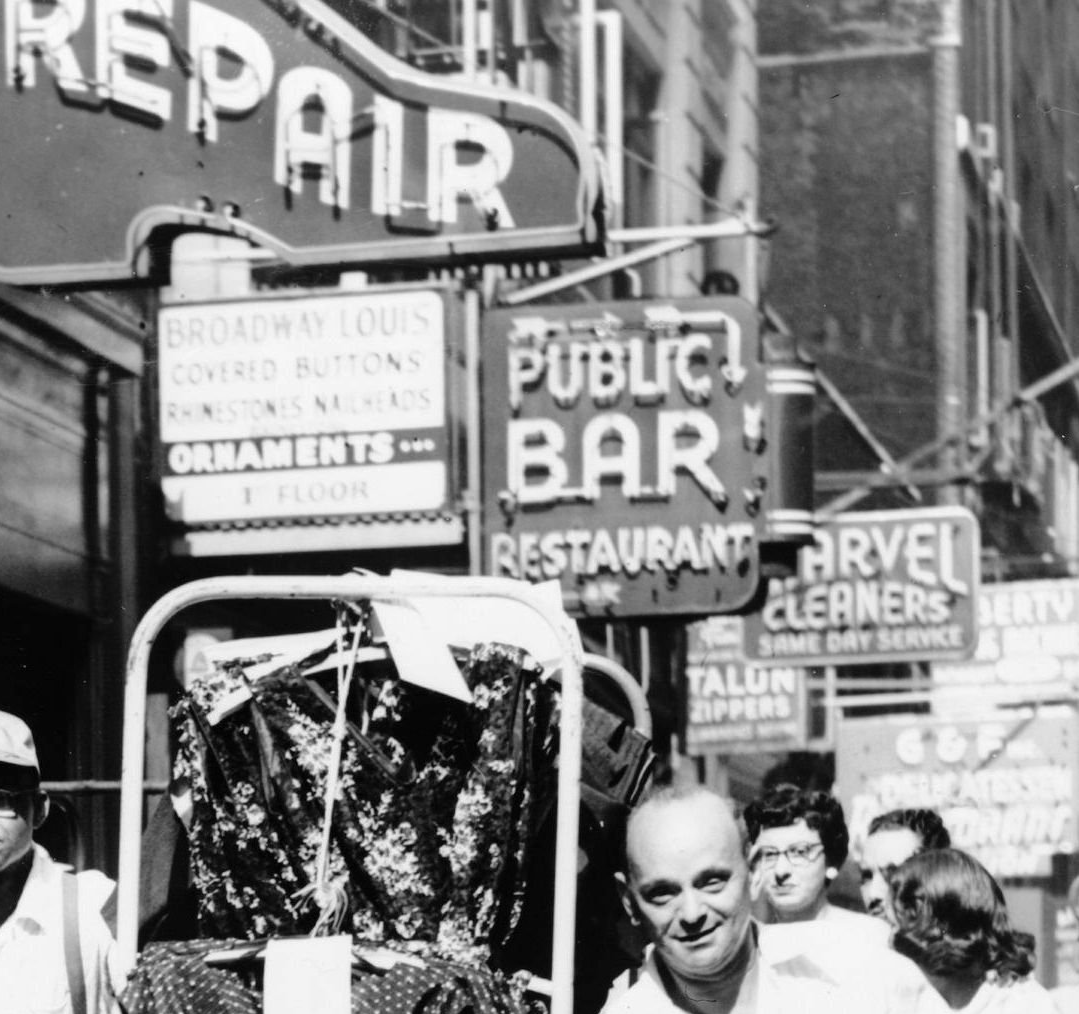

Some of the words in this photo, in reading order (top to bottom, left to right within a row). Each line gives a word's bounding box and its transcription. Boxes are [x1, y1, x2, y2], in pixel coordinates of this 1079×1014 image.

[5, 0, 514, 228] REPAIR
[166, 311, 326, 348] BROADWAY
[339, 302, 429, 337] LOUIS
[171, 358, 277, 386] COVERED
[295, 350, 420, 379] BUTTONS
[508, 334, 712, 408] PUBLIC
[168, 432, 394, 473] ORNAMENTS
[507, 409, 726, 504] BAR
[278, 480, 370, 503] FLOOR
[491, 521, 754, 578] RESTAURANT
[762, 580, 952, 631] CLEANERS
